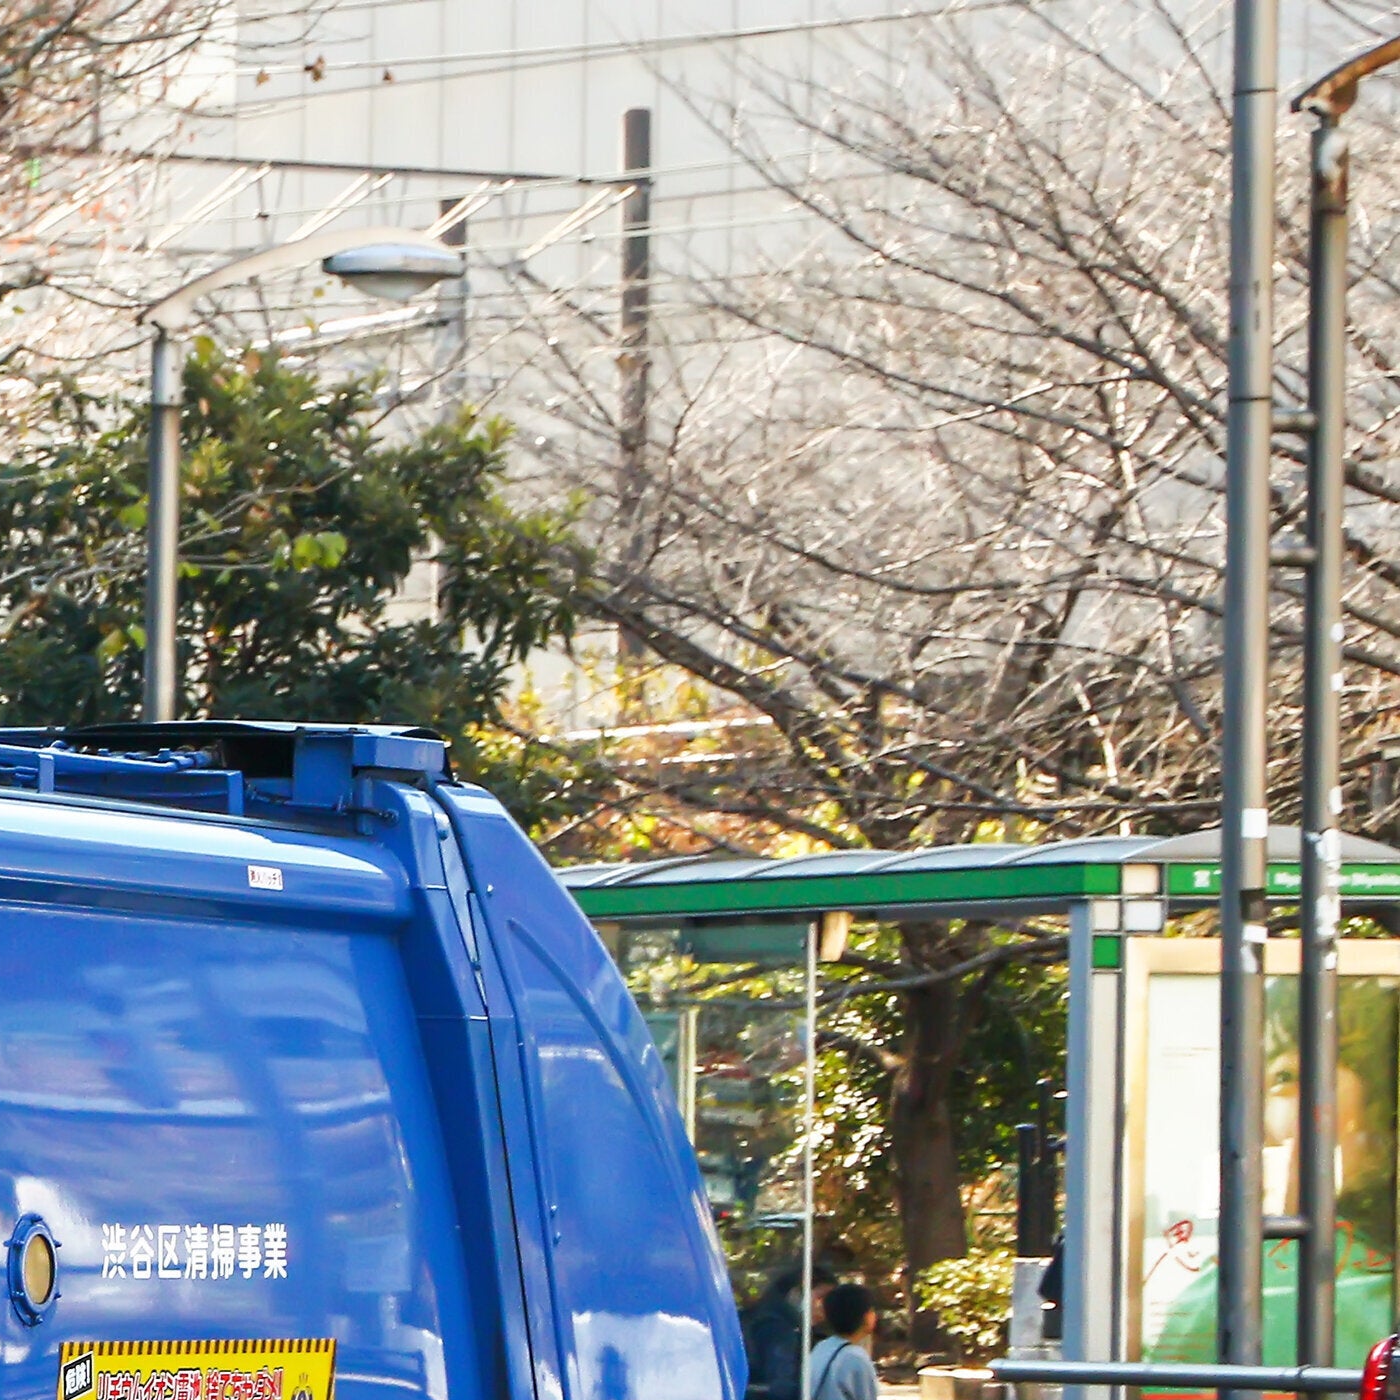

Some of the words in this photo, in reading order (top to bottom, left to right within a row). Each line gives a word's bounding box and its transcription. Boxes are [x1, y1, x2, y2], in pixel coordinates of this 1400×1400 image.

[102, 1223, 288, 1280] 渋谷区清掃事業
